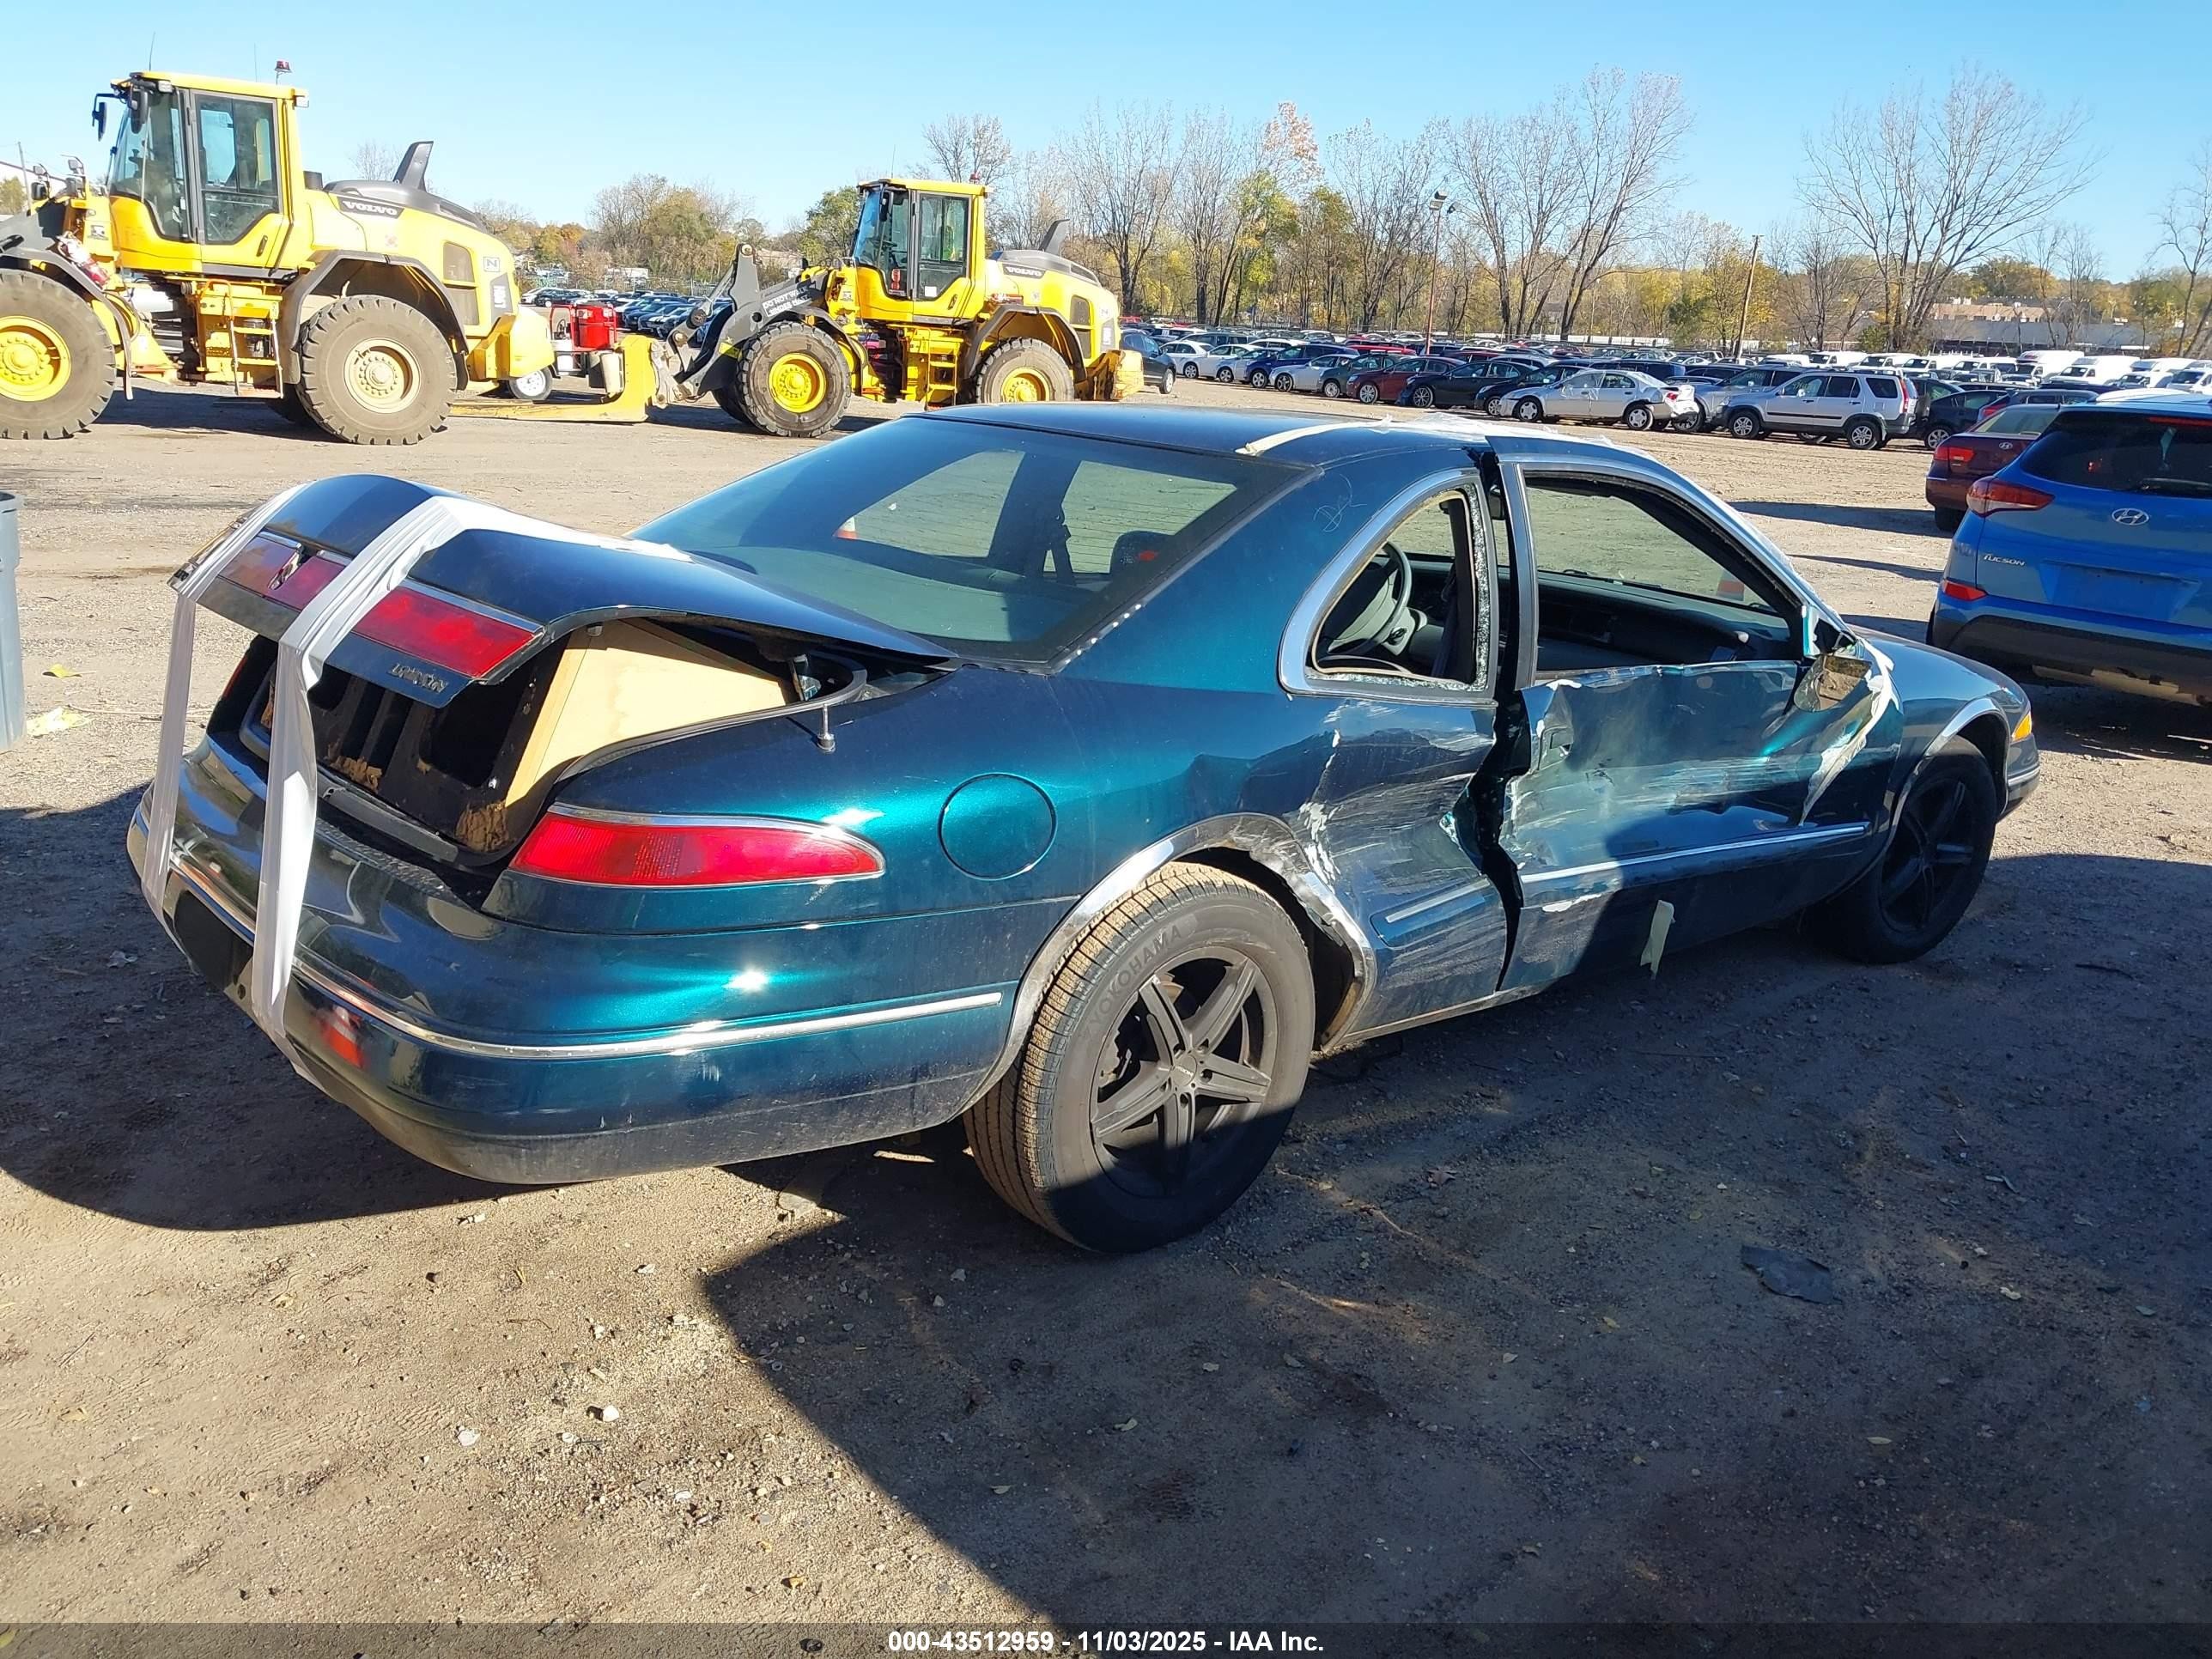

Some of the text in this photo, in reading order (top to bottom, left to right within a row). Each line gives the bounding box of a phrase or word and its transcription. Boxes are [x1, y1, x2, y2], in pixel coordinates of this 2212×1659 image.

[342, 200, 398, 216] VOLVO
[1005, 266, 1042, 276] VOLVO
[775, 295, 788, 306] NOT
[789, 286, 808, 298] WALK
[1984, 553, 2026, 566] TUCSON
[1089, 924, 1182, 1025] YOKOHAMA
